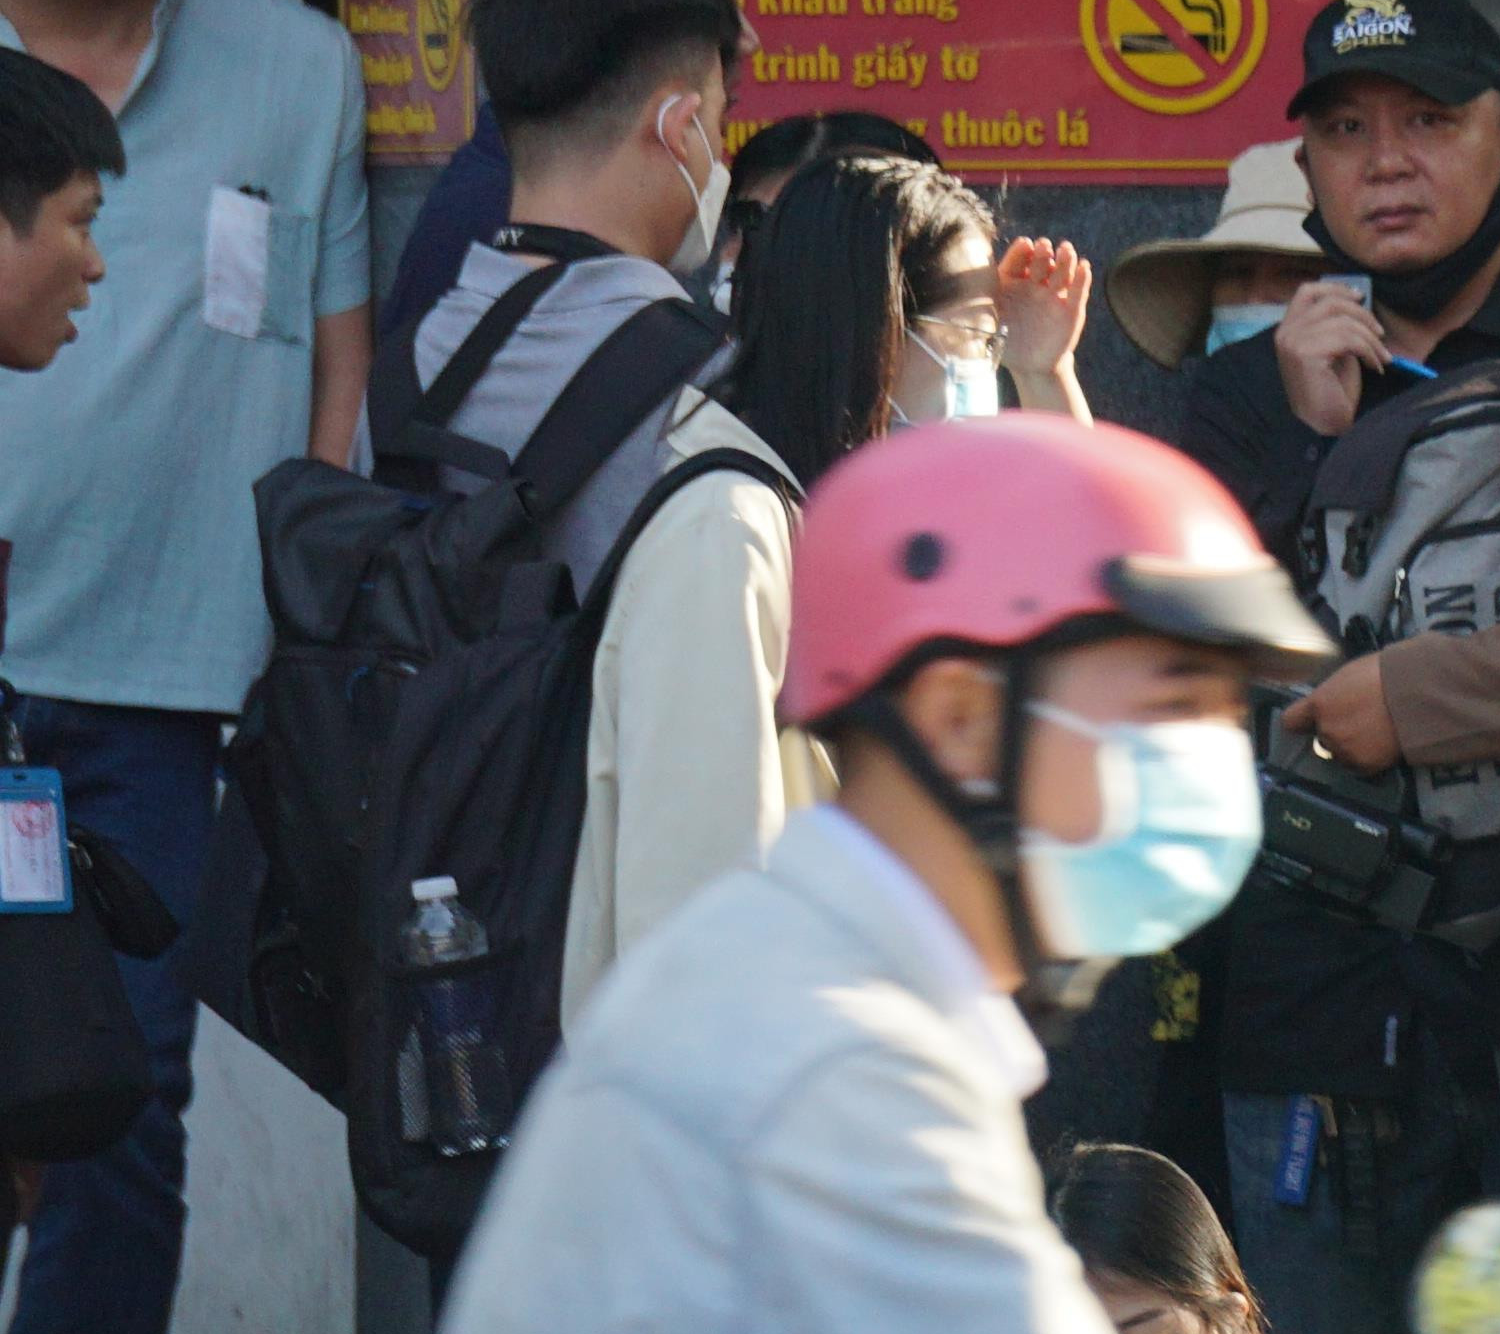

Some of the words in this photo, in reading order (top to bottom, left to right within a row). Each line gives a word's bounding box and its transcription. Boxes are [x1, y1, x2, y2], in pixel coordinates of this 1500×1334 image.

[1332, 13, 1411, 48] SAIGON
[852, 37, 928, 89] giấy
[1056, 106, 1090, 149] lá
